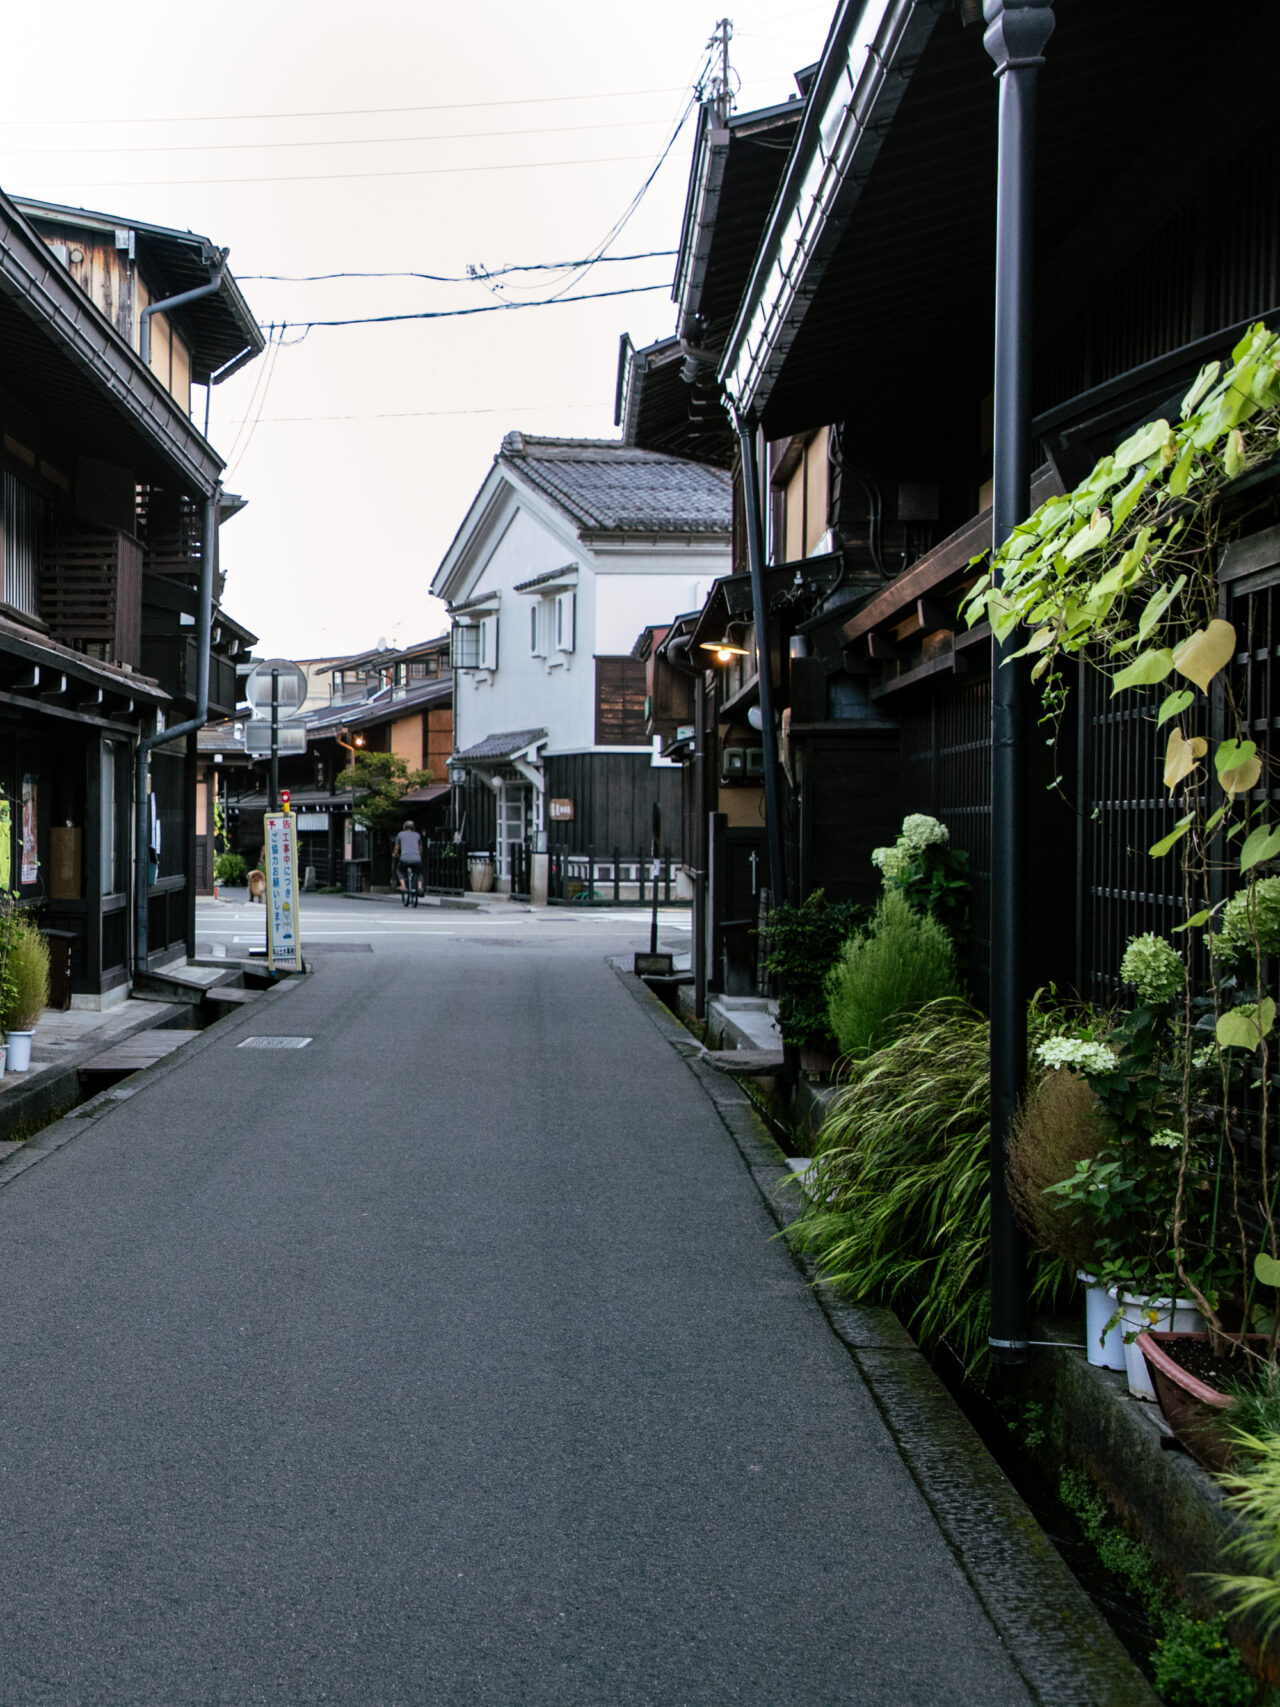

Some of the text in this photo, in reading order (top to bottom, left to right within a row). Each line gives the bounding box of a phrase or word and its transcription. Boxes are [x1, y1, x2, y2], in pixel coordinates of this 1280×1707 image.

[268, 819, 291, 830] 予告
[283, 832, 291, 899] 工事中につき
